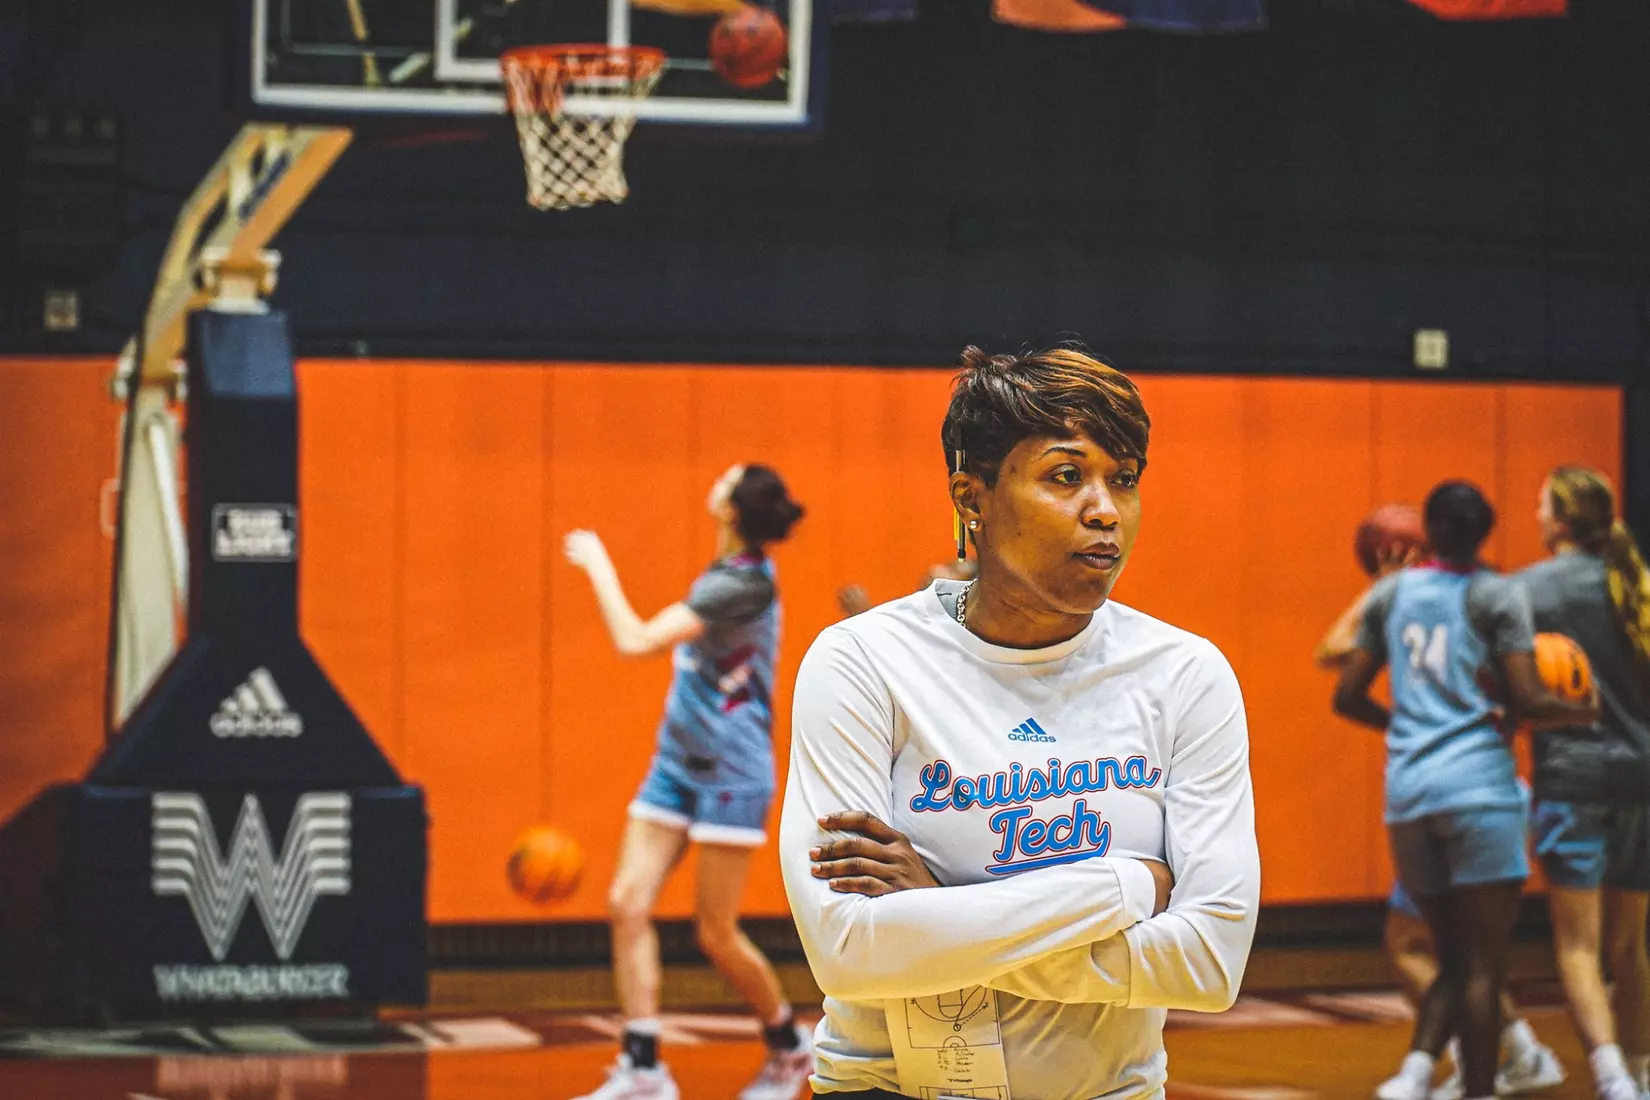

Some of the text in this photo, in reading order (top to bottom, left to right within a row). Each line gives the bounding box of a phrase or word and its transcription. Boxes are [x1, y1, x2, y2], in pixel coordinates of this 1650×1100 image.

[1402, 622, 1448, 682] 24
[1008, 733, 1056, 742] adidas
[909, 755, 1162, 812] Louisiana
[988, 798, 1111, 864] Tech
